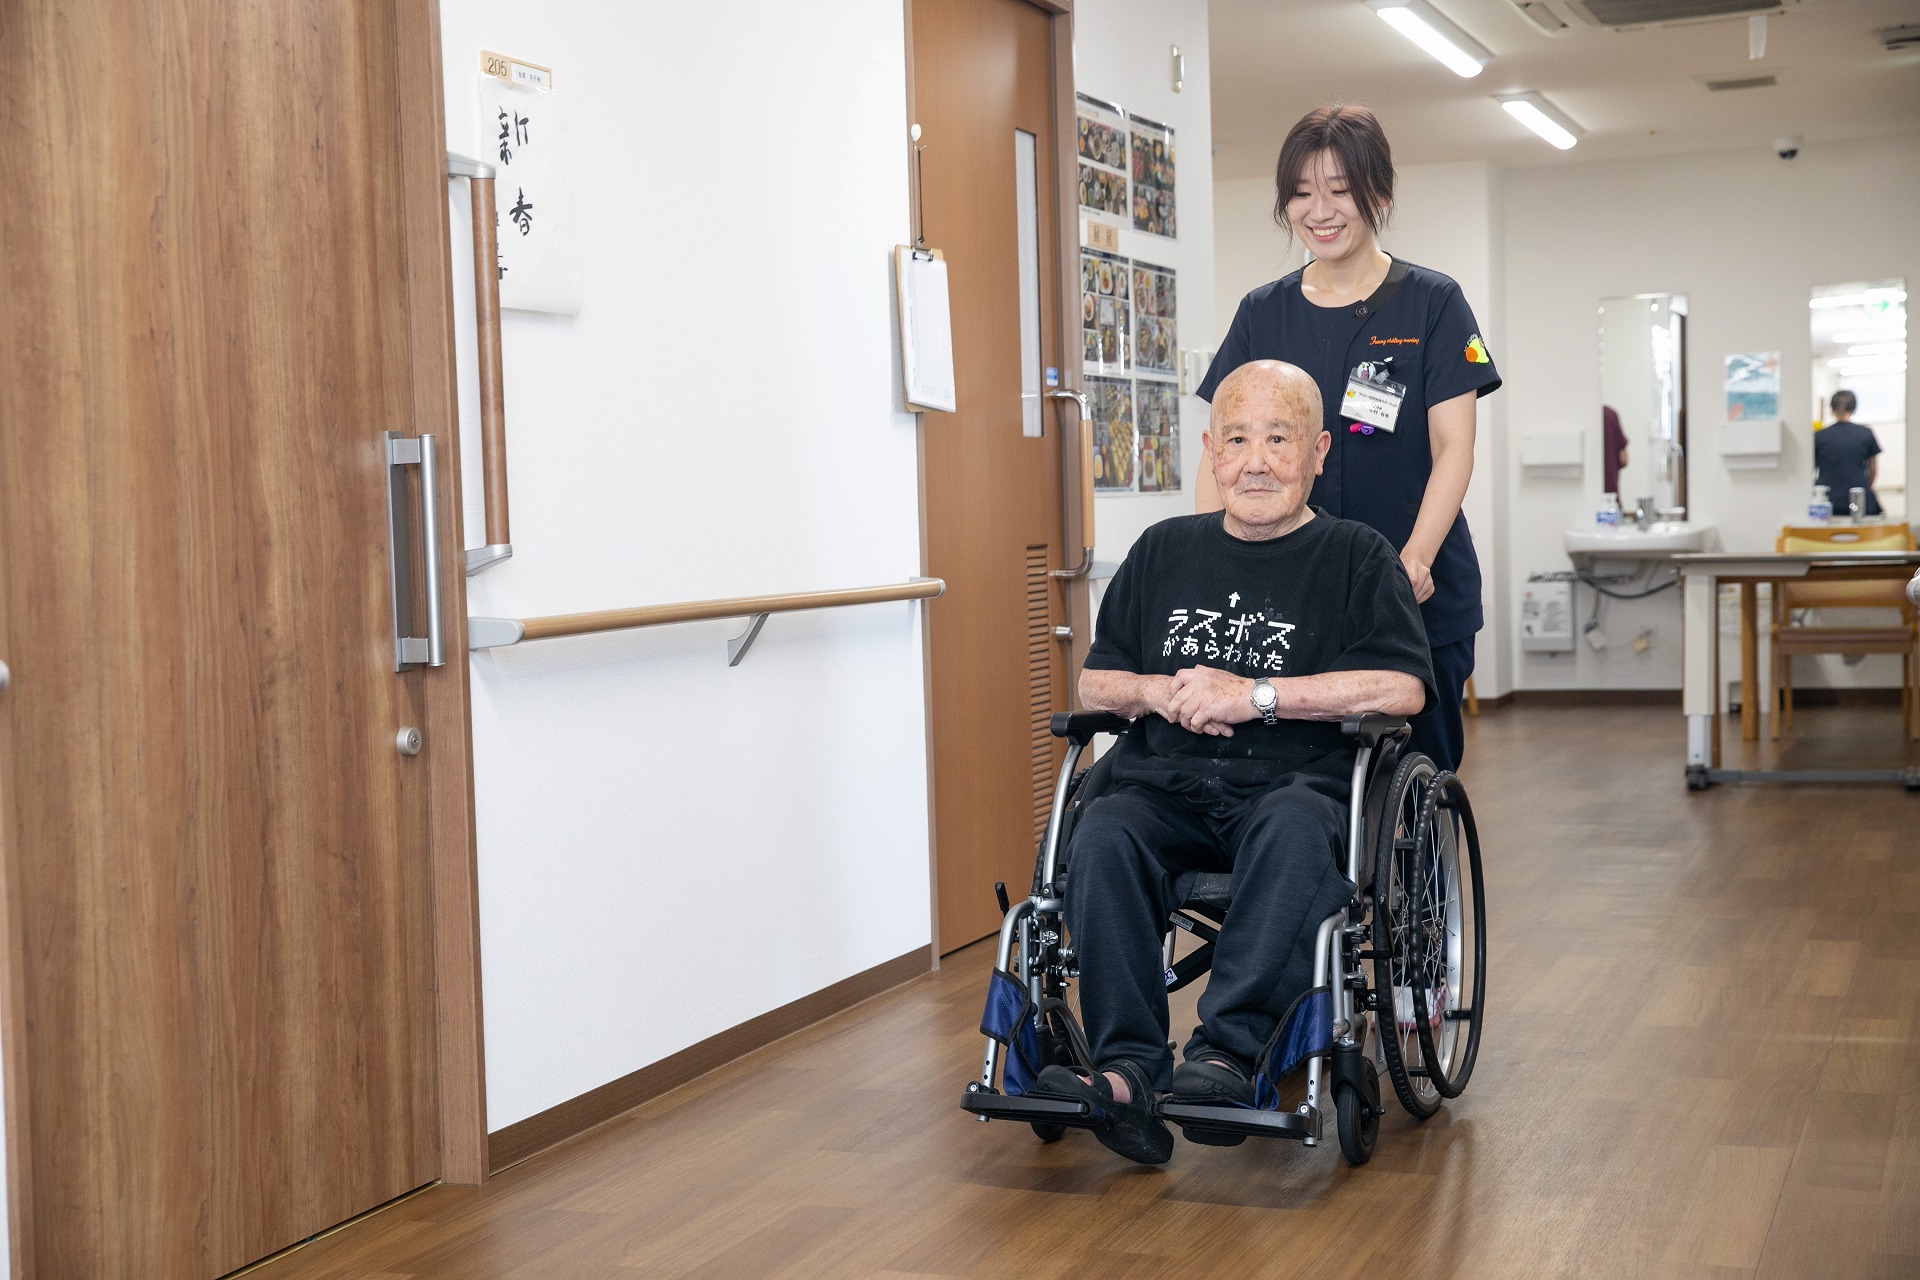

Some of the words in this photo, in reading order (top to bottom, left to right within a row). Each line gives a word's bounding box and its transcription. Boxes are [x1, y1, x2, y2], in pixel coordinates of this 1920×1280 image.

[487, 57, 507, 77] 205
[1168, 608, 1296, 650] ラスボス
[1162, 635, 1284, 671] があらわれた
